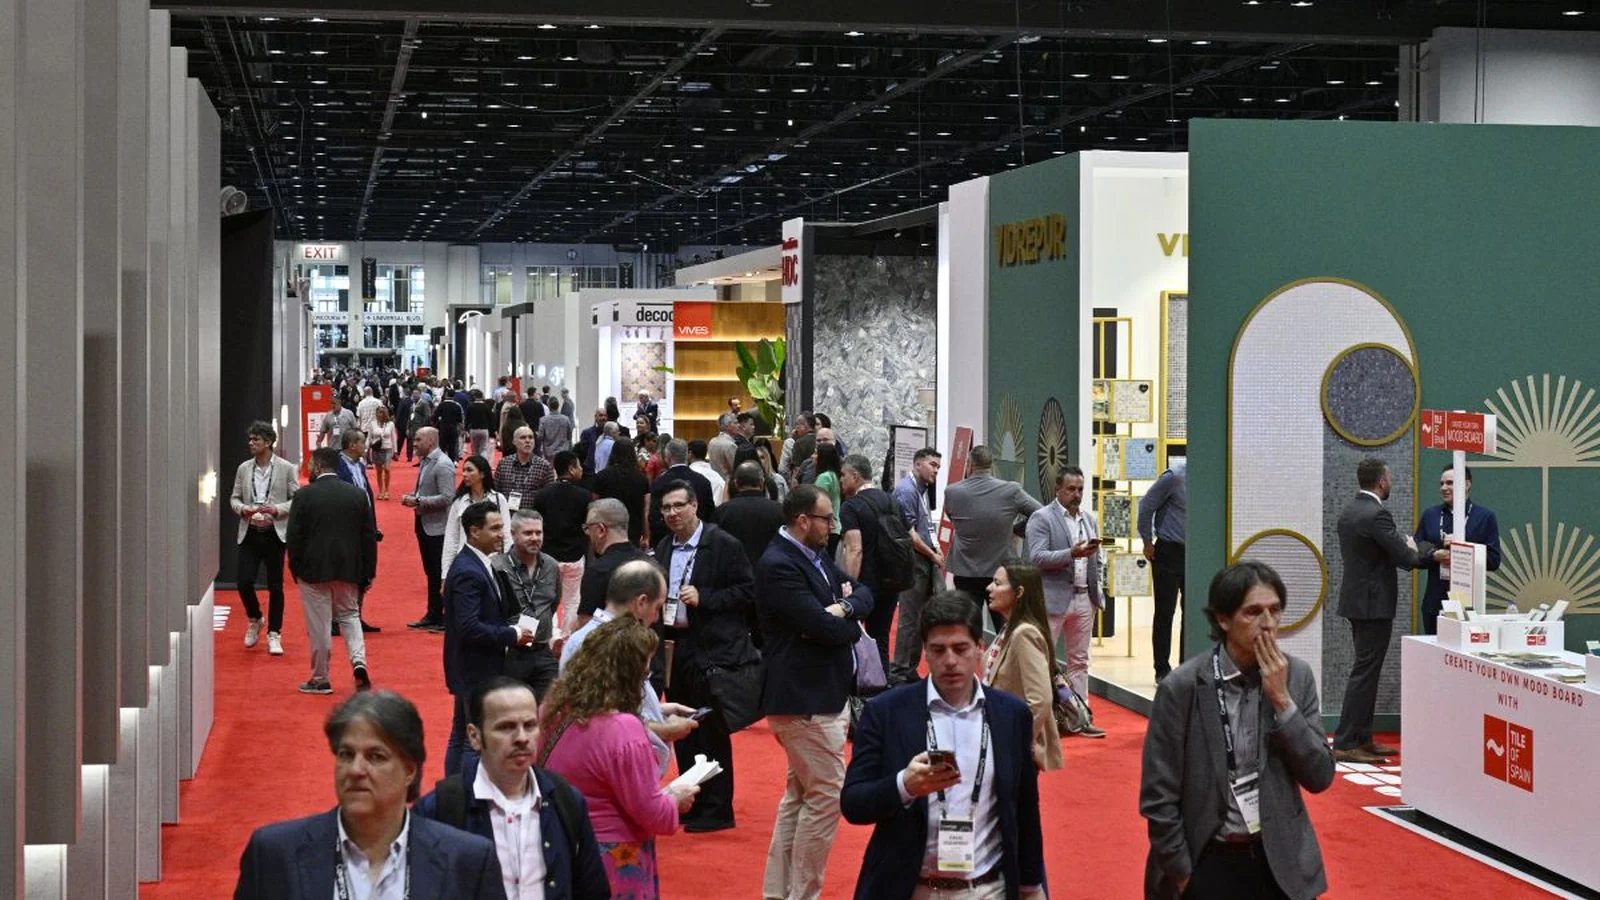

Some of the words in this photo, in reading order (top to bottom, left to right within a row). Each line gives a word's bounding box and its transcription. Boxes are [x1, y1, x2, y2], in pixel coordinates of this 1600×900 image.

[304, 247, 337, 259] EXIT
[678, 326, 709, 335] VIVES
[1444, 653, 1473, 672] CREATE
[1476, 663, 1497, 679] YOUR
[1501, 671, 1519, 686] OWN
[1523, 678, 1548, 695] MOOD
[1552, 687, 1584, 707] BOARD
[1497, 693, 1518, 709] WITH
[1510, 730, 1526, 749] TILE
[1510, 749, 1519, 762] OF
[1510, 764, 1531, 784] SPAIN
